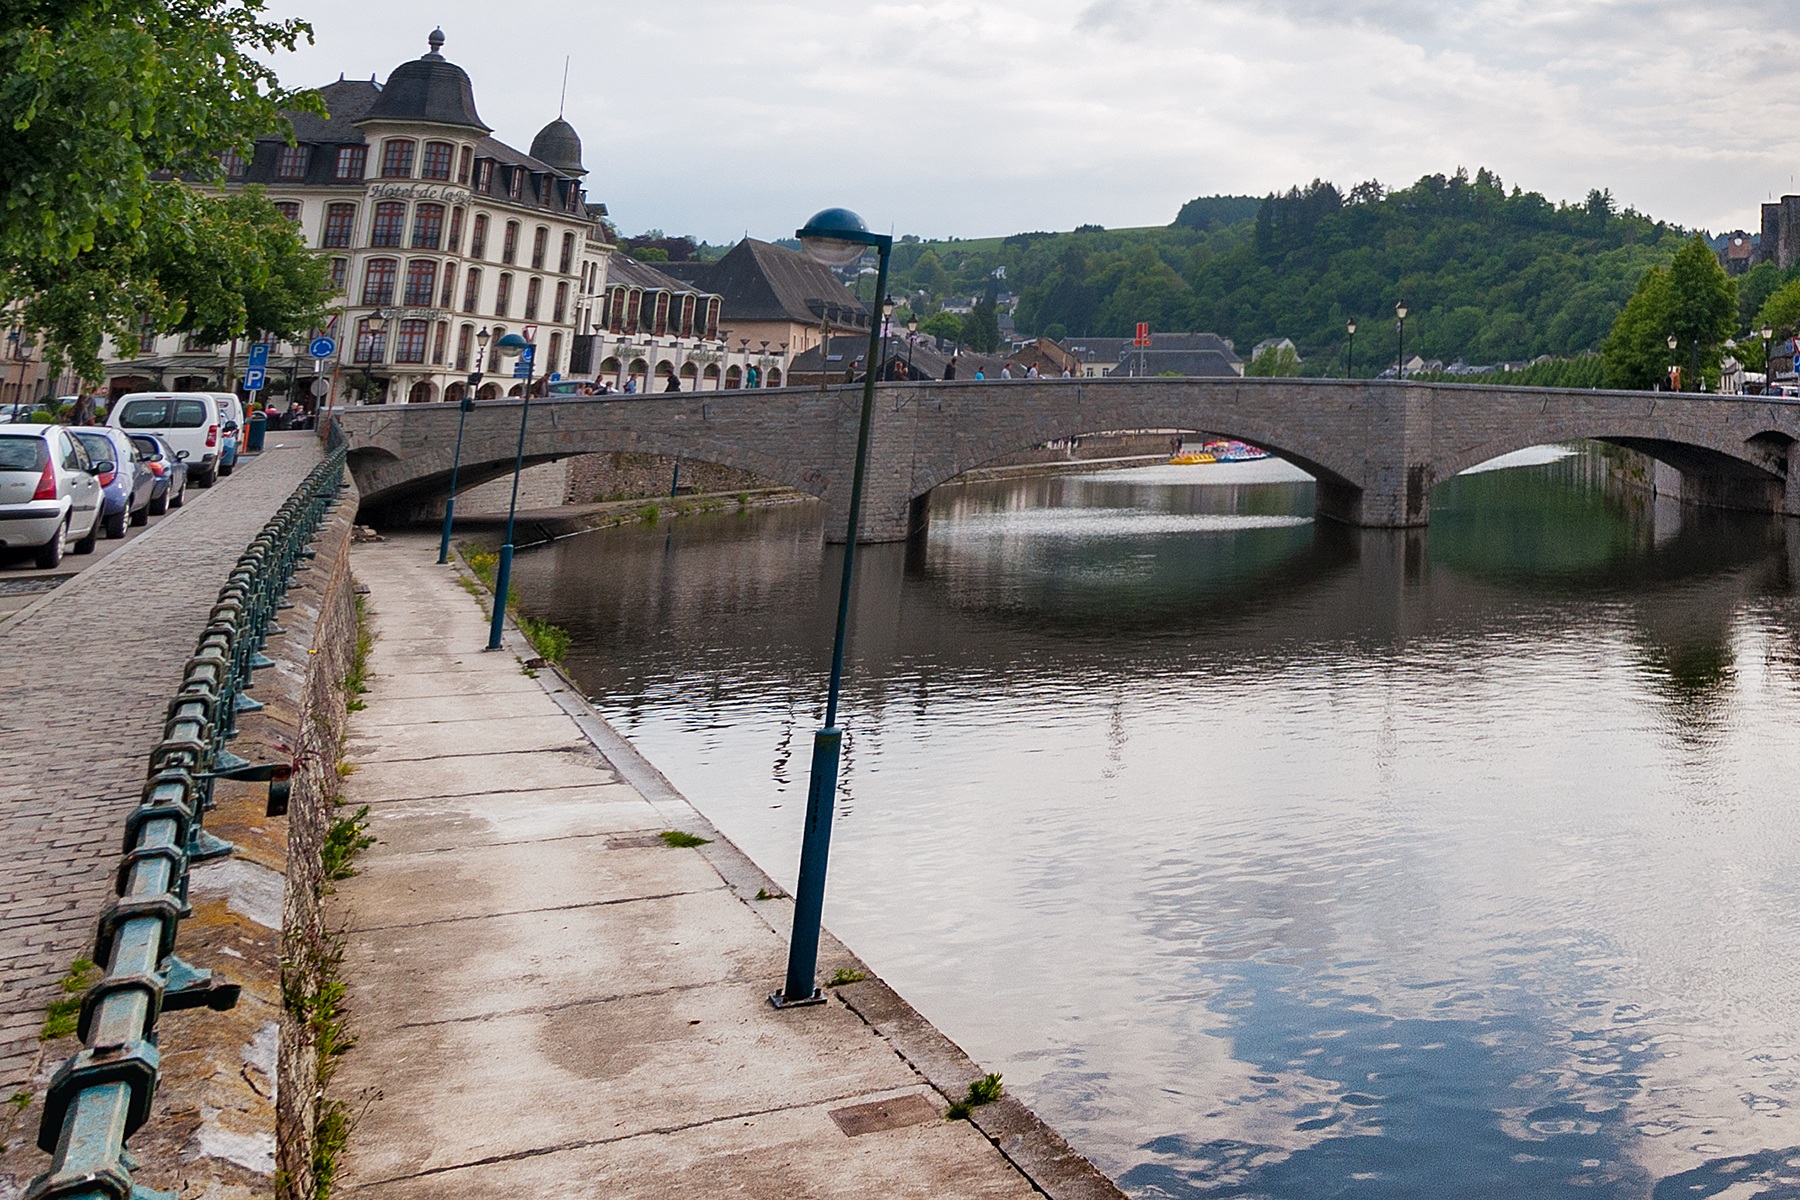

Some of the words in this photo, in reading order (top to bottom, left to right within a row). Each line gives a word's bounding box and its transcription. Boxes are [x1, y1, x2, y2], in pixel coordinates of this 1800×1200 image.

[418, 183, 437, 199] de
[253, 346, 265, 358] P
[247, 371, 262, 386] P
